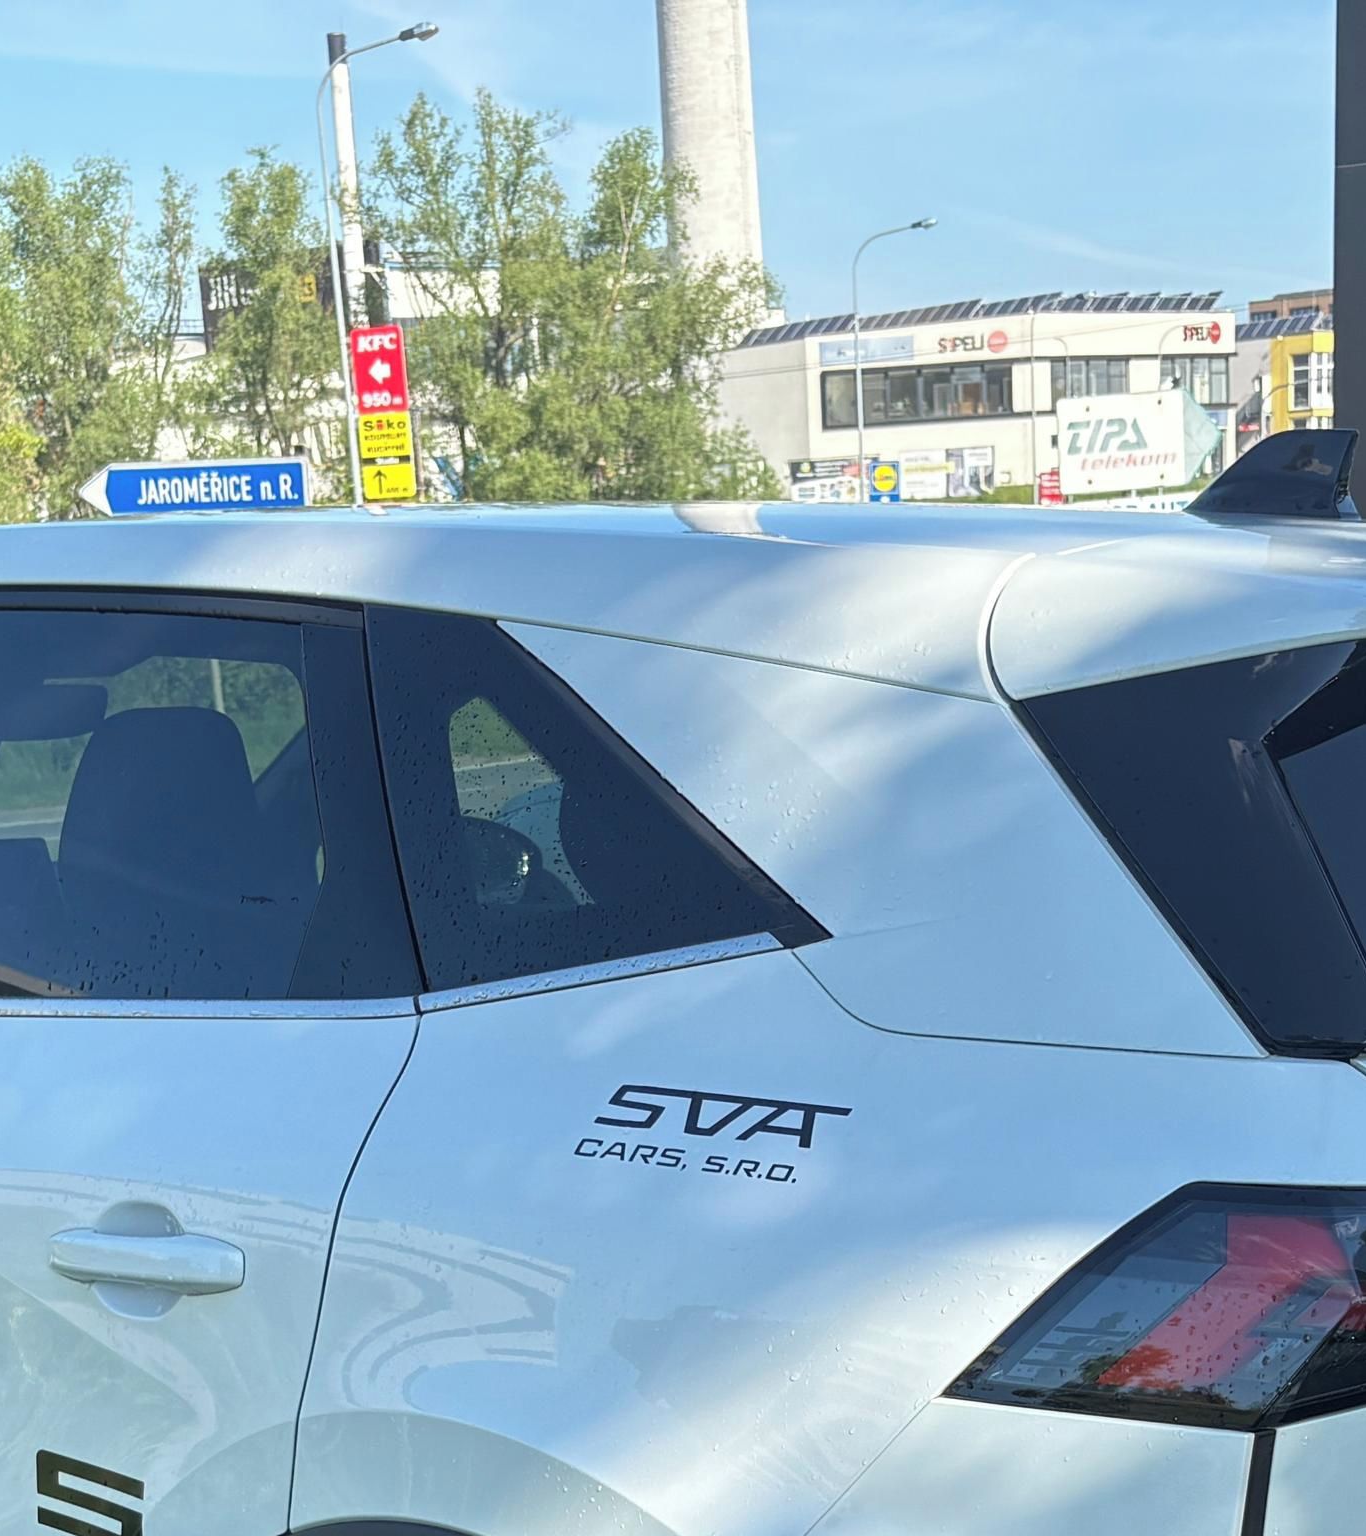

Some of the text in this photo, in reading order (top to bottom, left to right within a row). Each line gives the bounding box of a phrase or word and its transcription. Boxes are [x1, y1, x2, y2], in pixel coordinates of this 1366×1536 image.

[357, 333, 398, 352] KFC
[362, 392, 391, 408] 950
[1067, 417, 1148, 456] TIPA
[1080, 452, 1178, 472] telekom
[137, 472, 299, 505] JAROMĚŘICE n. R.
[593, 1084, 853, 1148] SVA
[573, 1138, 797, 1184] CARS, S.R.O.
